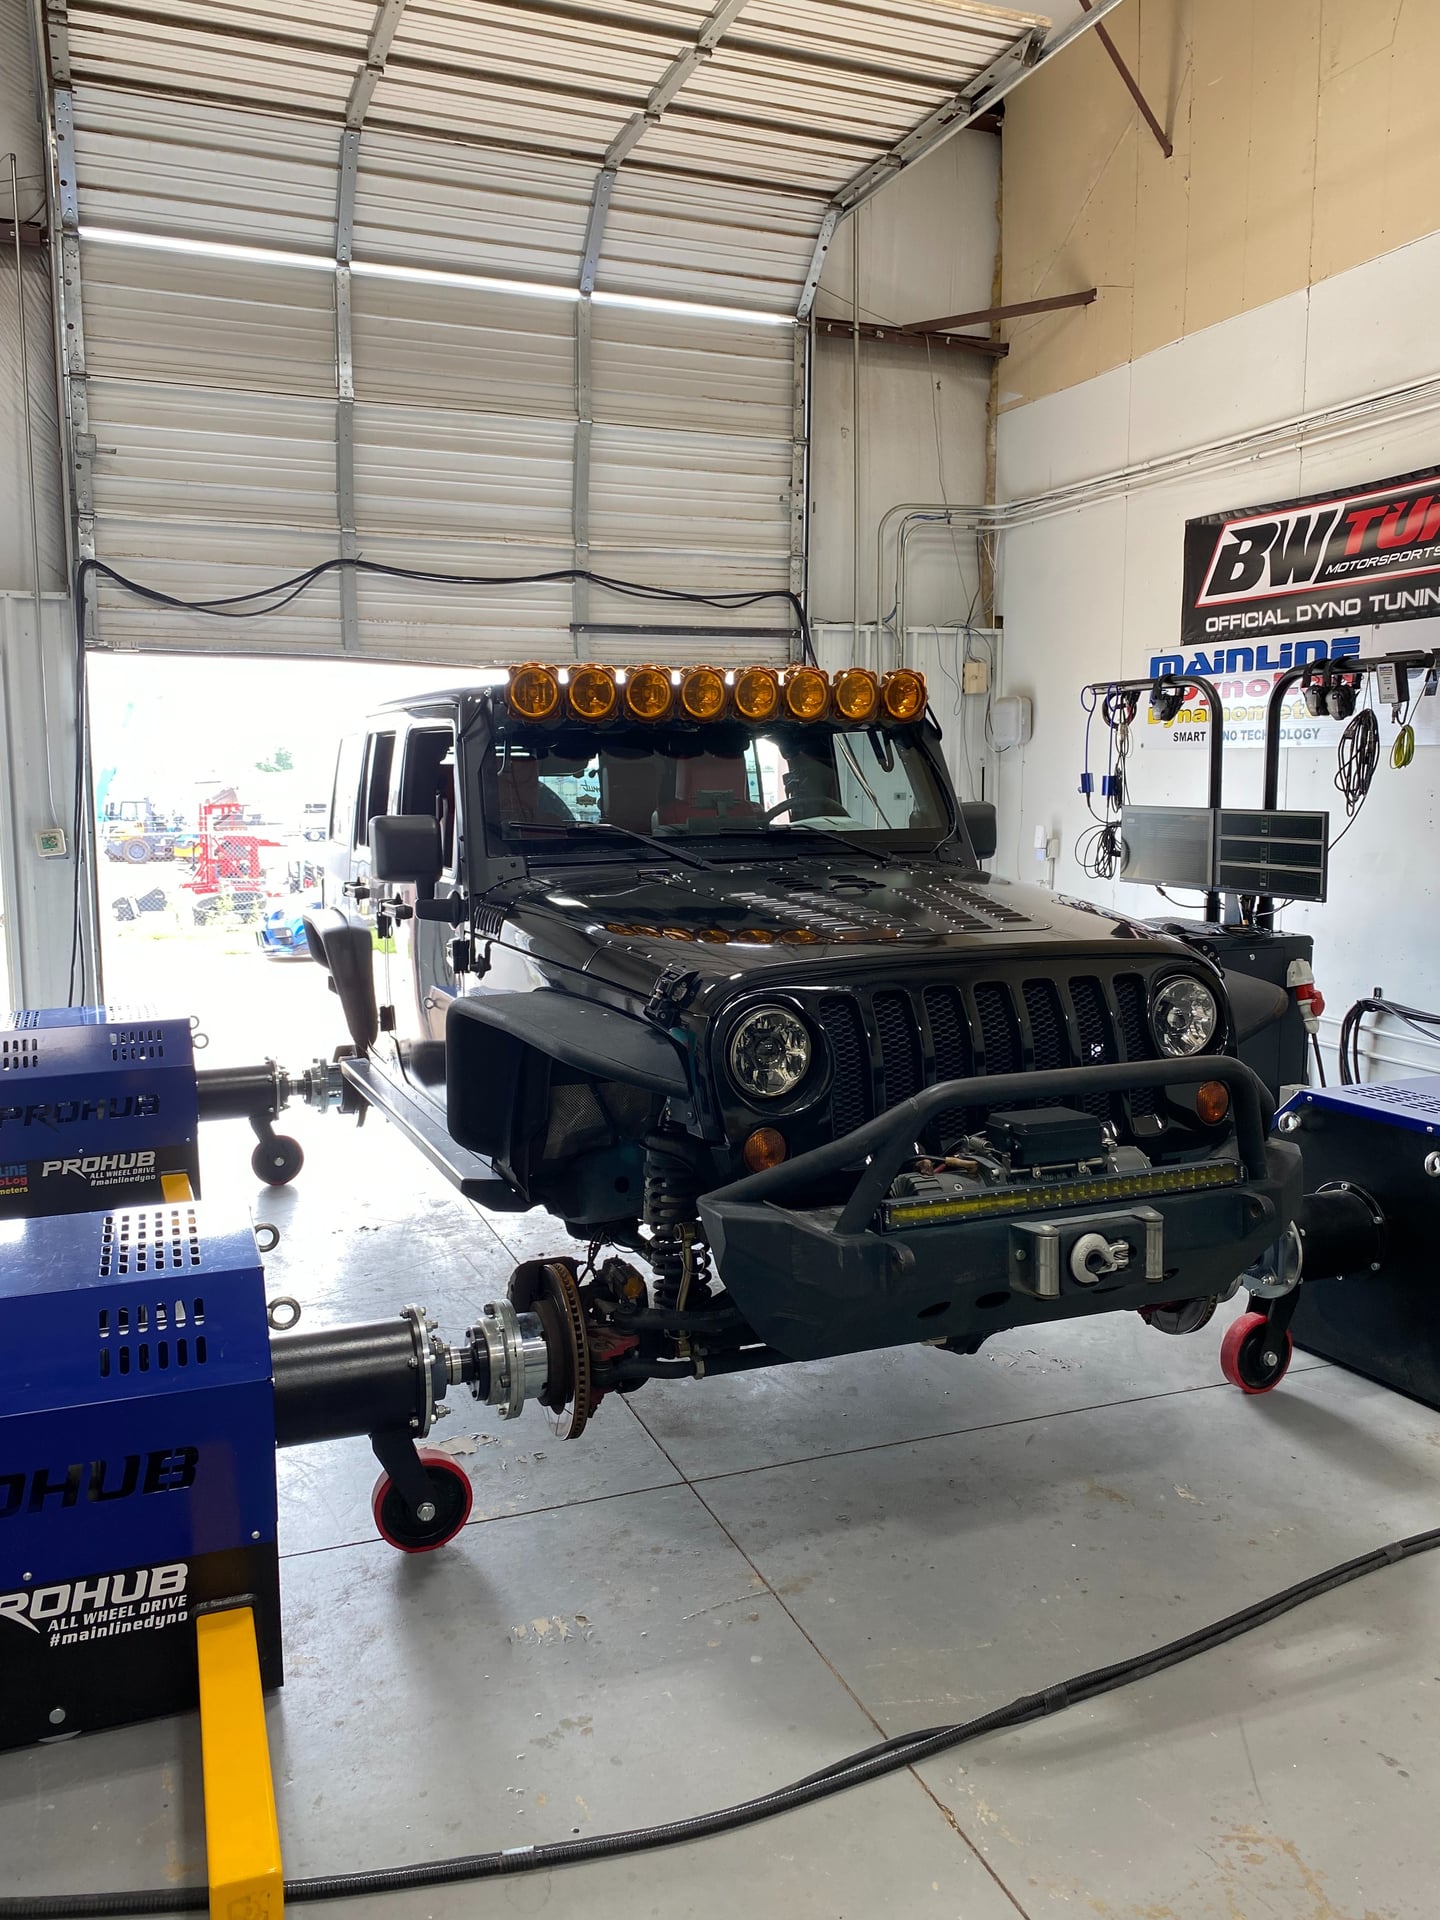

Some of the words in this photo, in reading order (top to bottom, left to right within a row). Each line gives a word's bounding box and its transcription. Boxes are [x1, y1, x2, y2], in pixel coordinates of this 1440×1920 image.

[1205, 507, 1340, 598] BW
[1325, 545, 1440, 575] MOTORSPORTS
[1205, 609, 1290, 632] OFFICIAL
[1296, 598, 1362, 622] DYNO
[1173, 731, 1207, 742] SMART
[1240, 727, 1321, 741] TECHOLOGY
[42, 1151, 156, 1180] PROHUB
[90, 1171, 105, 1179] ALL
[106, 1168, 131, 1177] WHEEL
[132, 1166, 156, 1175] DRIVE
[90, 1174, 156, 1187] #mainlinedyno
[48, 1617, 78, 1632] ALL
[83, 1606, 136, 1625] WHEEL
[140, 1594, 187, 1615] DRIVE
[50, 1611, 188, 1647] #mainlinedyno
